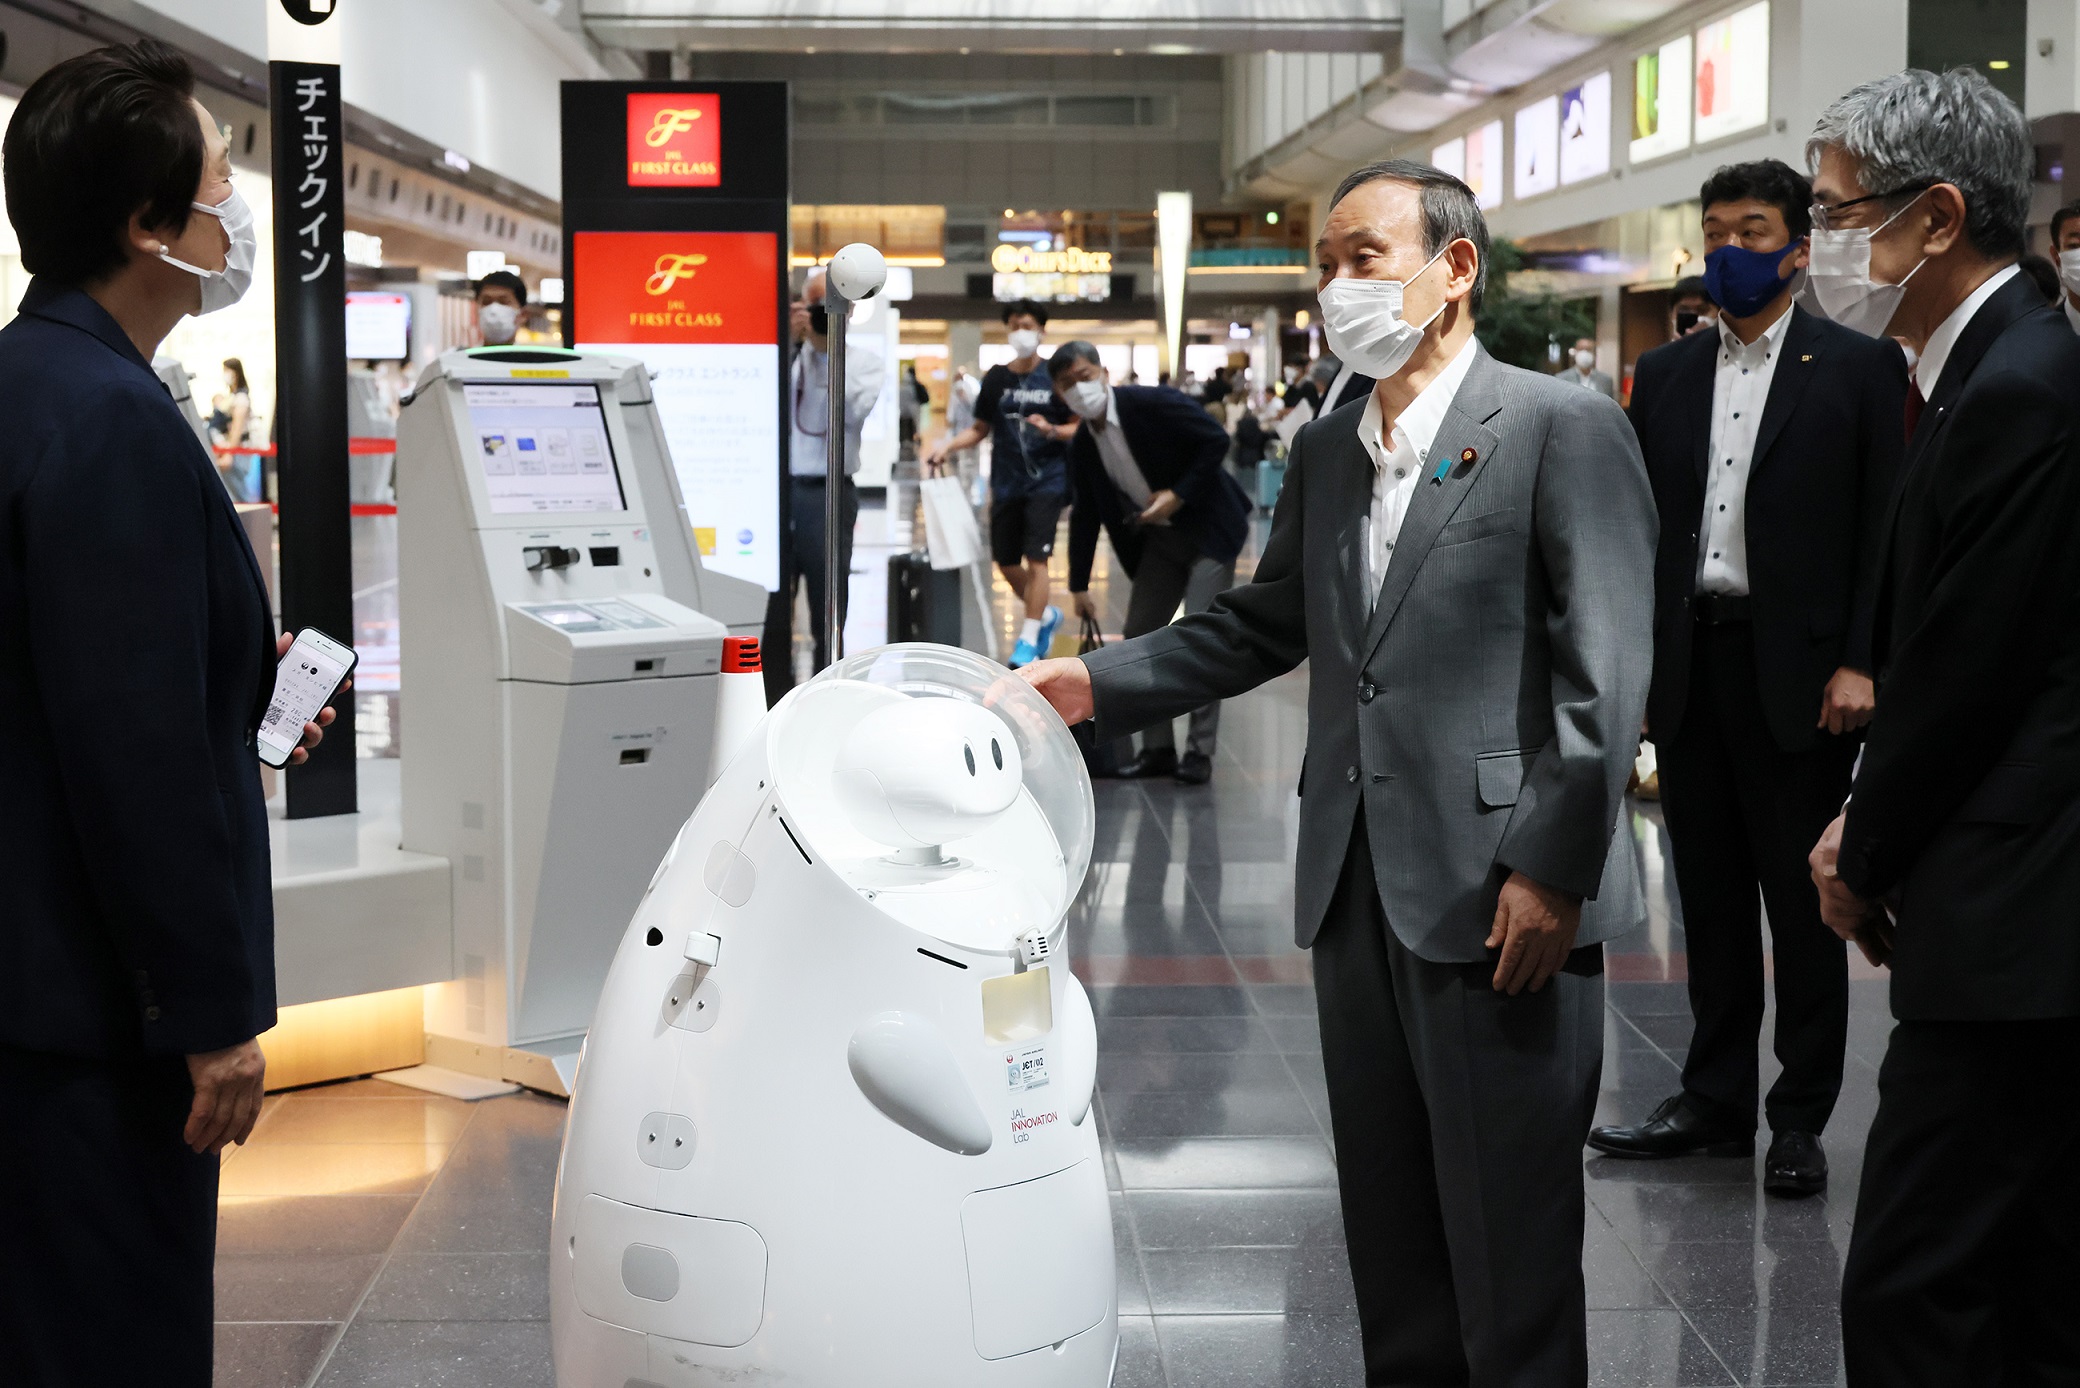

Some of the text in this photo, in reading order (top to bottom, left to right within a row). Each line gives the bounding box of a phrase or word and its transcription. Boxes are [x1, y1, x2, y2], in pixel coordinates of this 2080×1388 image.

[632, 161, 717, 175] FIRST CLASS
[295, 77, 331, 283] チェックイン
[629, 312, 723, 327] FIRST CLASS
[1010, 1108, 1026, 1121] JAL
[1011, 1112, 1058, 1132] INNOVATION
[1013, 1132, 1030, 1144] Lab
